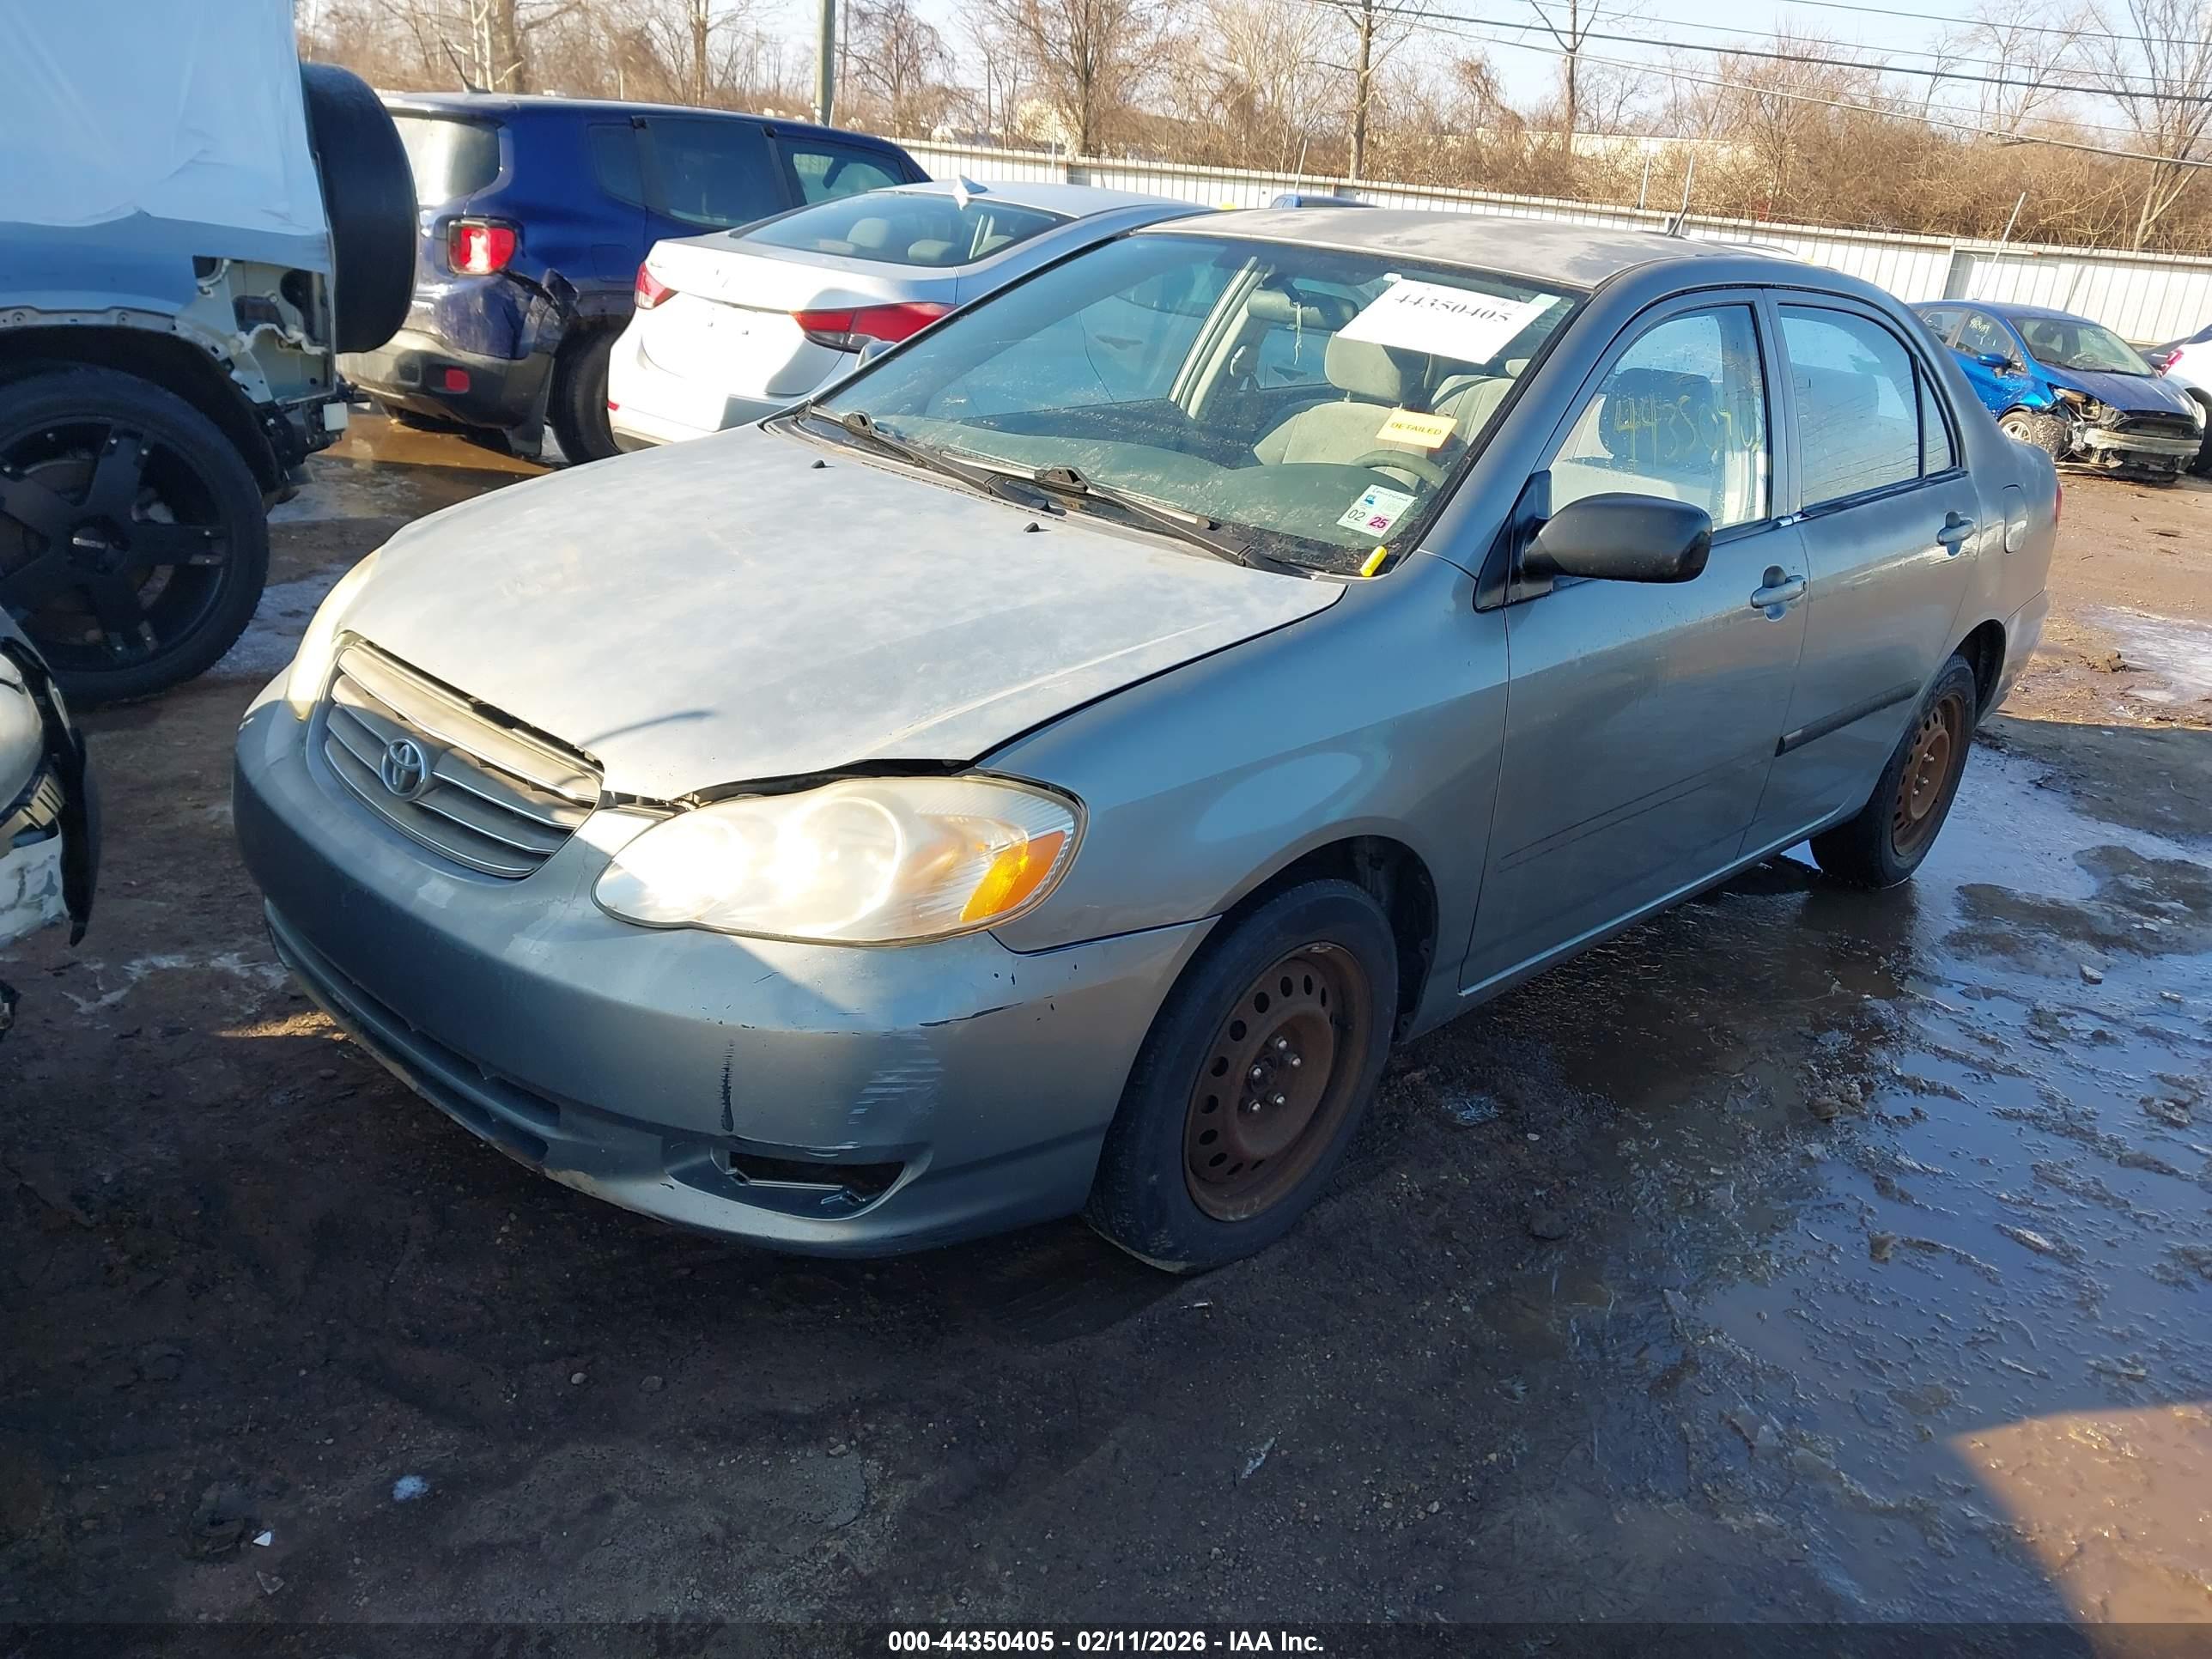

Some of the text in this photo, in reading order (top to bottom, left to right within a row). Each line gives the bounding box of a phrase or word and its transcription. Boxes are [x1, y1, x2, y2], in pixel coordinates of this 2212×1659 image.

[1395, 294, 1512, 321] 44350405
[1389, 421, 1443, 436] DETAILED
[1347, 509, 1389, 529] 02 25
